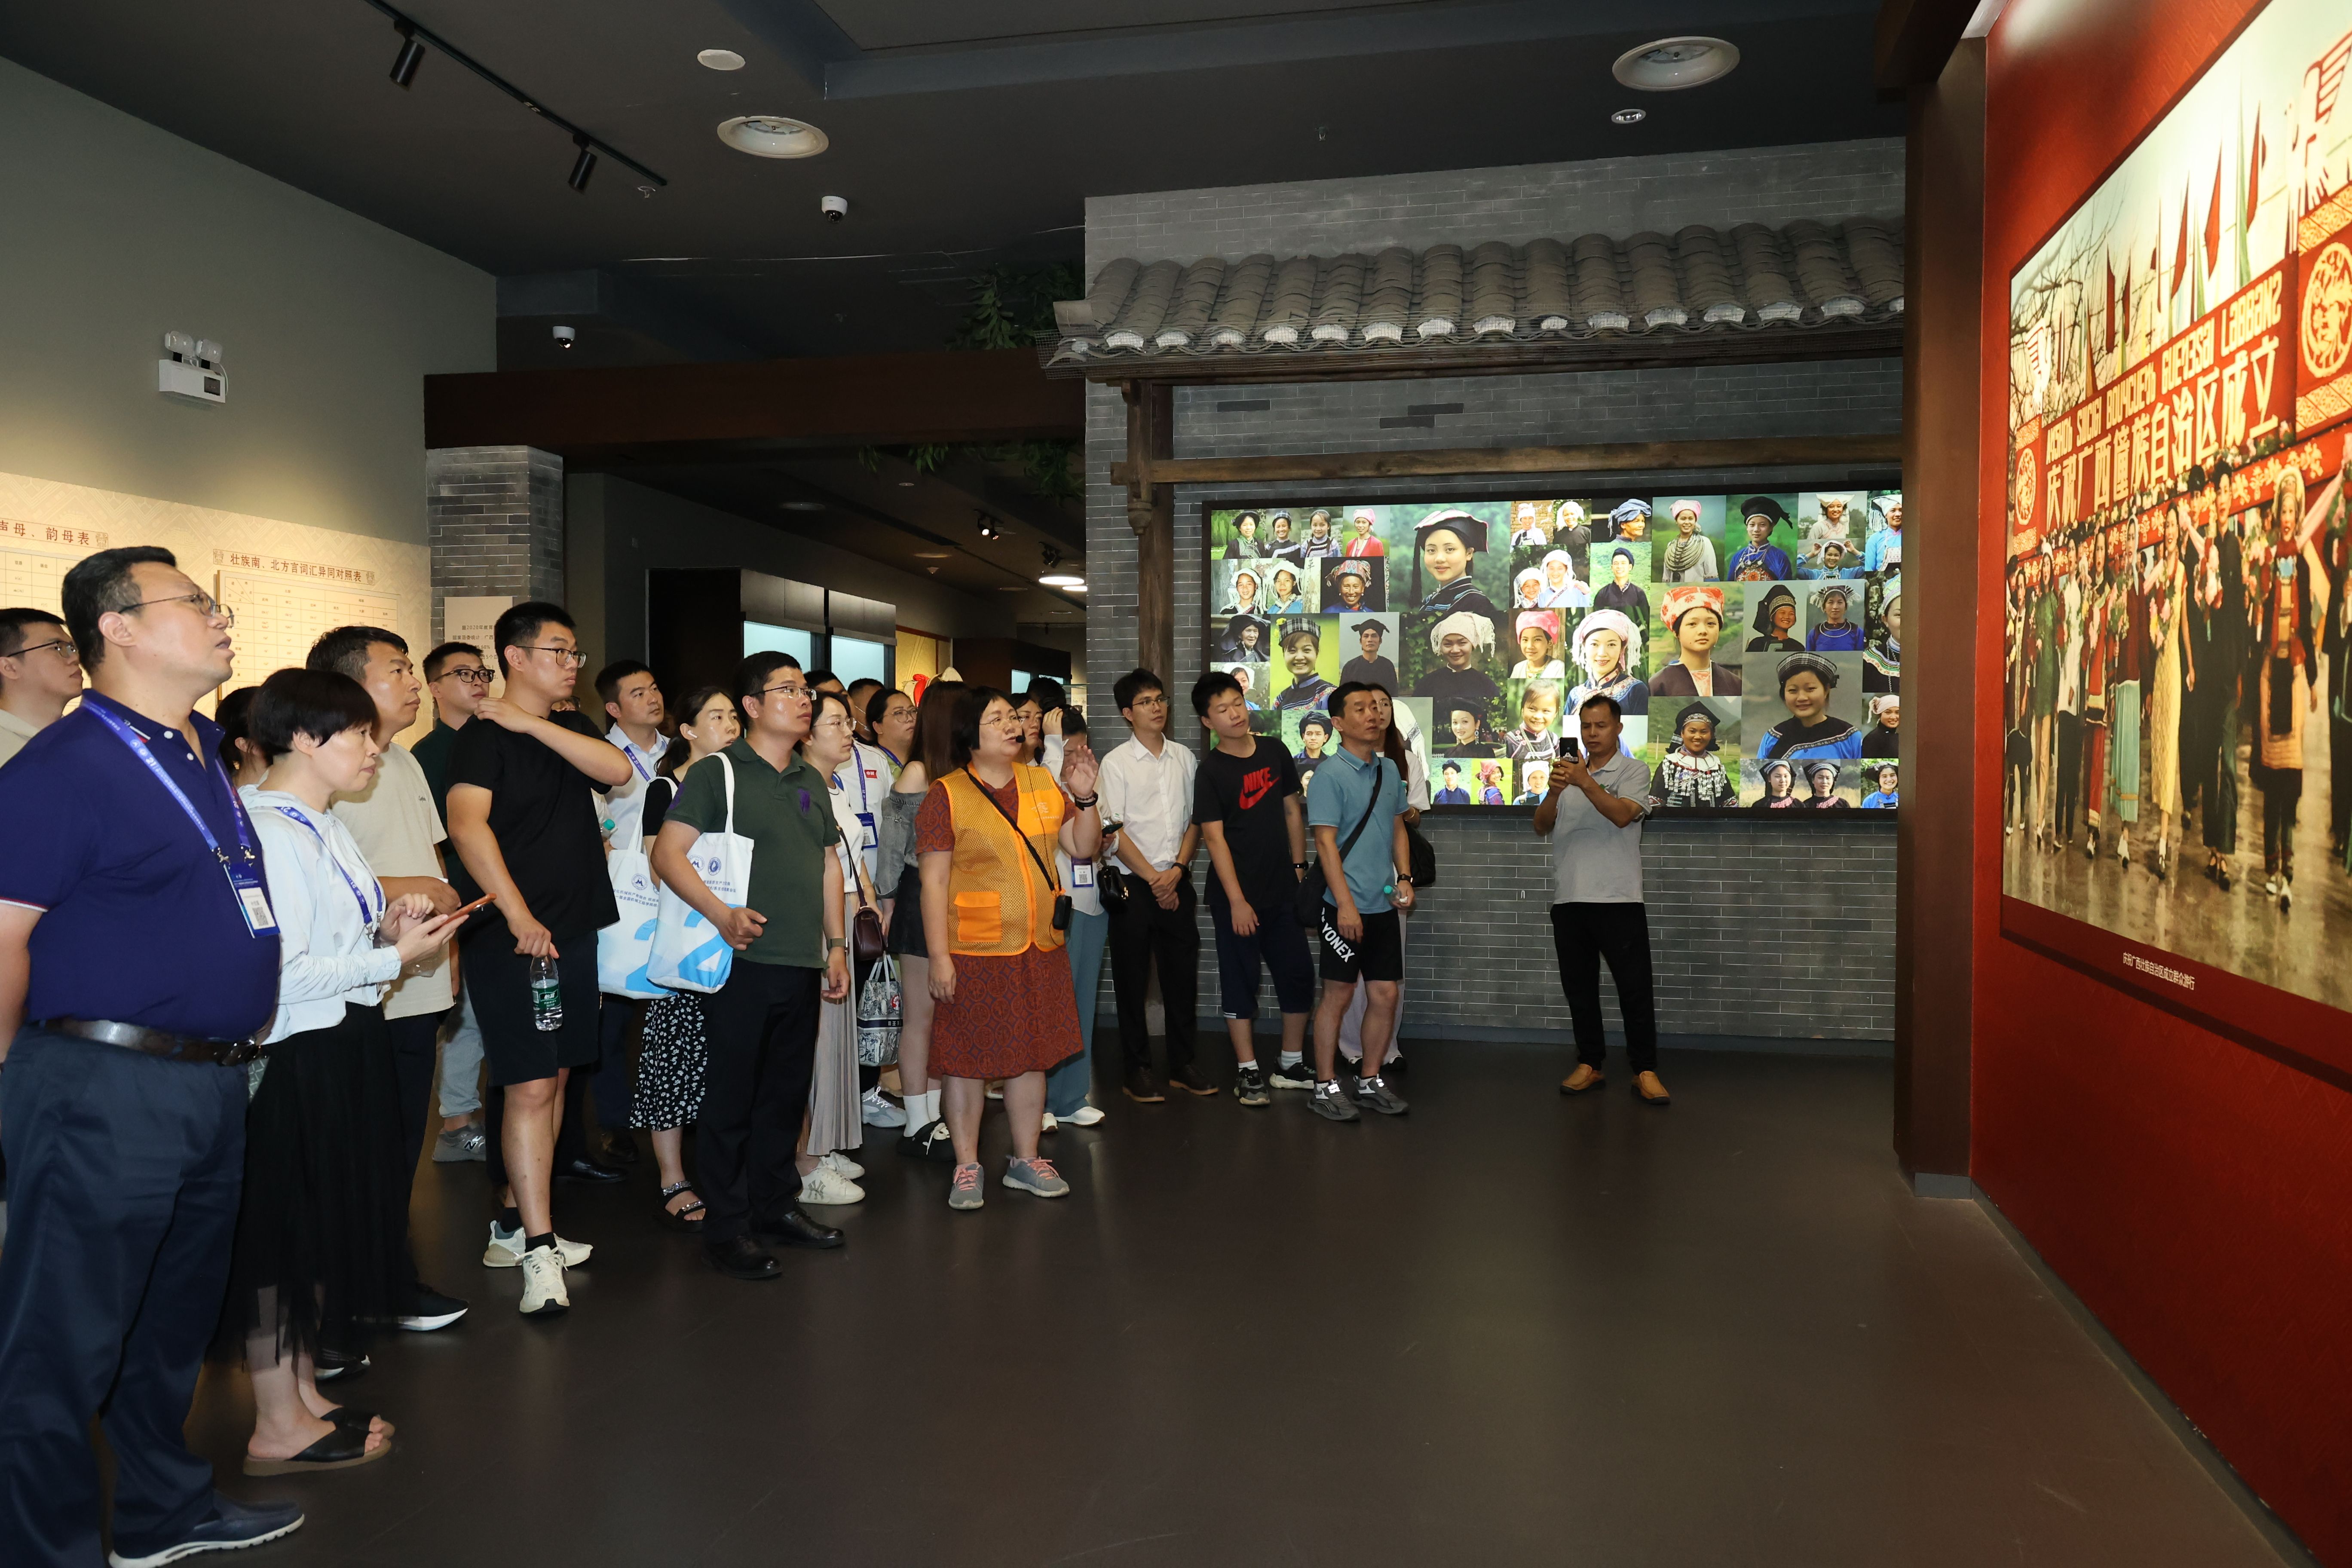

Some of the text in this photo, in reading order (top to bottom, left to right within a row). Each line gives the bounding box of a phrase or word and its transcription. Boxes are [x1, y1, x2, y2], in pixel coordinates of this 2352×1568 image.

[230, 553, 362, 582] 壮族南、北方言词汇异同对照表
[1243, 767, 1272, 793] NIKE
[1322, 922, 1355, 963] YONEX
